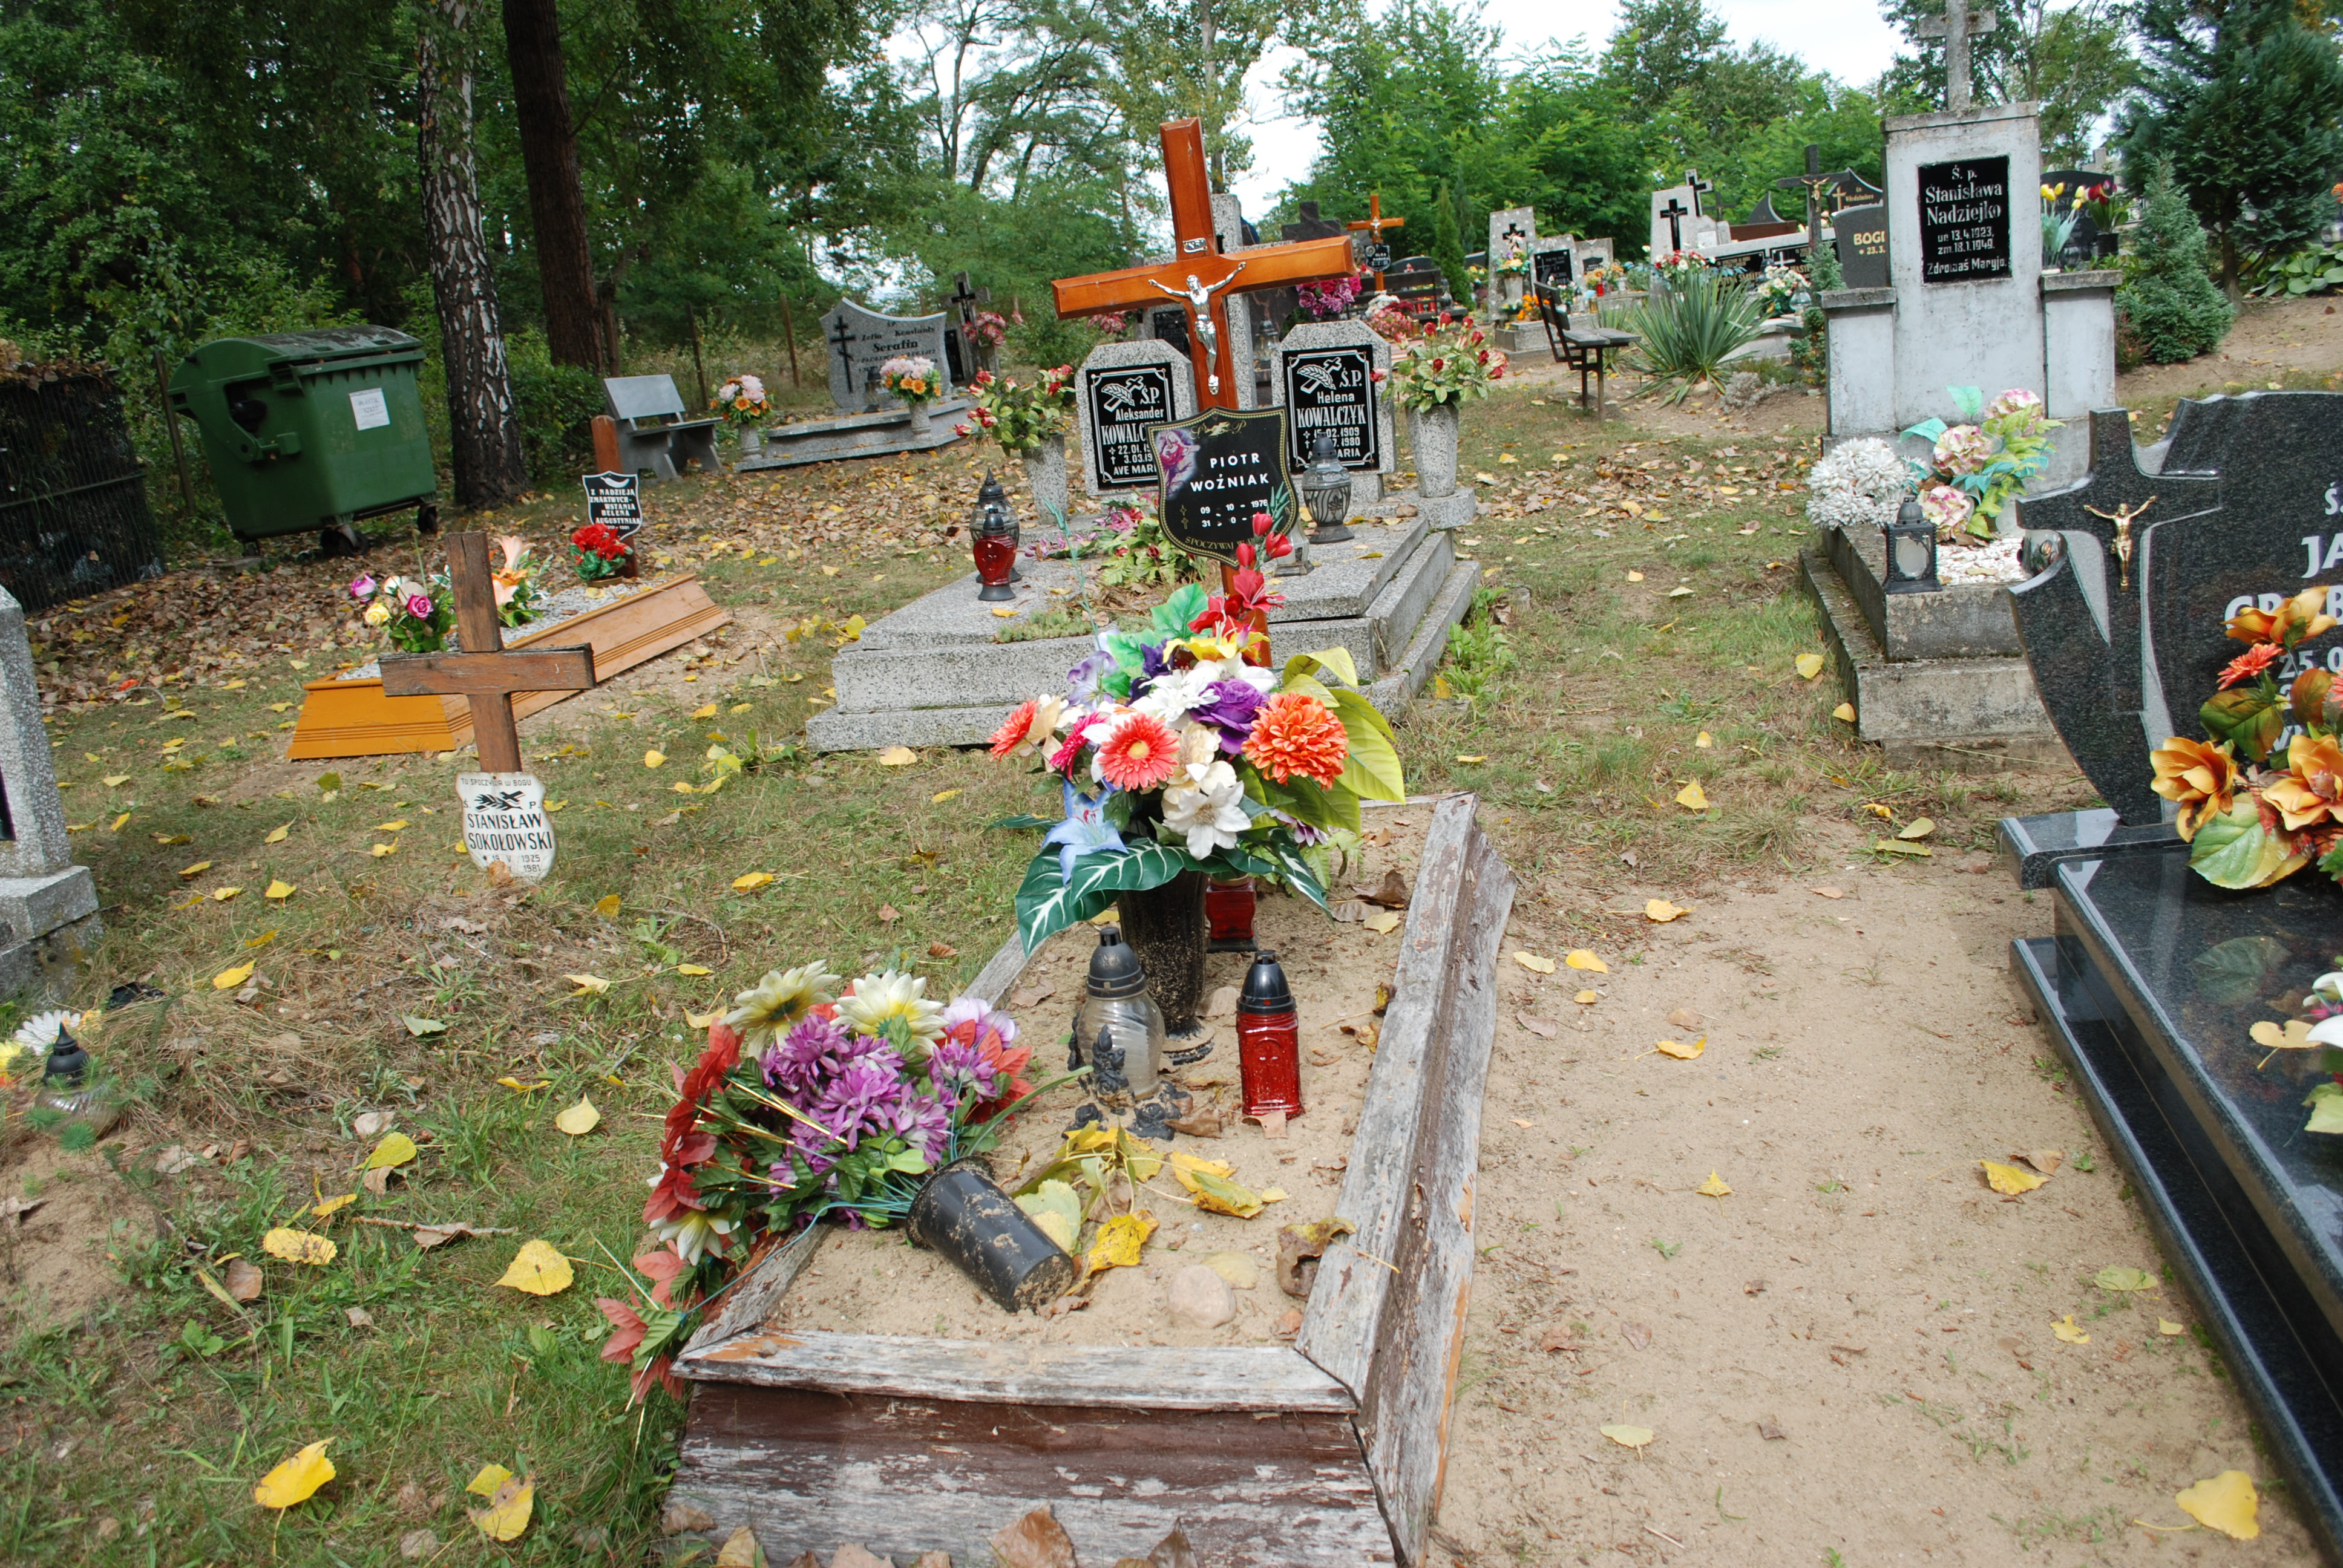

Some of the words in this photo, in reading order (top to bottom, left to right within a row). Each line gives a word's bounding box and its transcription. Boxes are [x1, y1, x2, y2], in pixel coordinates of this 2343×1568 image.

[1951, 165, 1963, 180] Ś.
[1967, 169, 1978, 181] p.
[1925, 181, 2002, 204] Stanisława
[1927, 200, 2001, 226] Nadziejko
[873, 339, 919, 353] Serafin
[1339, 367, 1363, 388] Ś.P.
[1140, 385, 1160, 405] Ś.P.
[1317, 391, 1355, 404] Helena
[1115, 406, 1164, 422] Aleksander
[1296, 404, 1366, 428] KOWALCZYK
[1101, 422, 1162, 445] KOWALC
[1124, 453, 1153, 463] 3.03.19
[1210, 452, 1260, 469] PIOTR
[1337, 448, 1361, 458] ARIA
[1113, 466, 1130, 475] AVE
[1131, 464, 1157, 474] MARI
[1190, 473, 1270, 492] WOŹNIAK
[1200, 506, 1211, 515] 09
[1225, 503, 1235, 512] 10
[1185, 536, 1234, 550] SPOCZYWAJ
[467, 812, 542, 829] STANISŁAW
[468, 831, 553, 851] SOKOŁOWSKI
[522, 854, 540, 863] 1925
